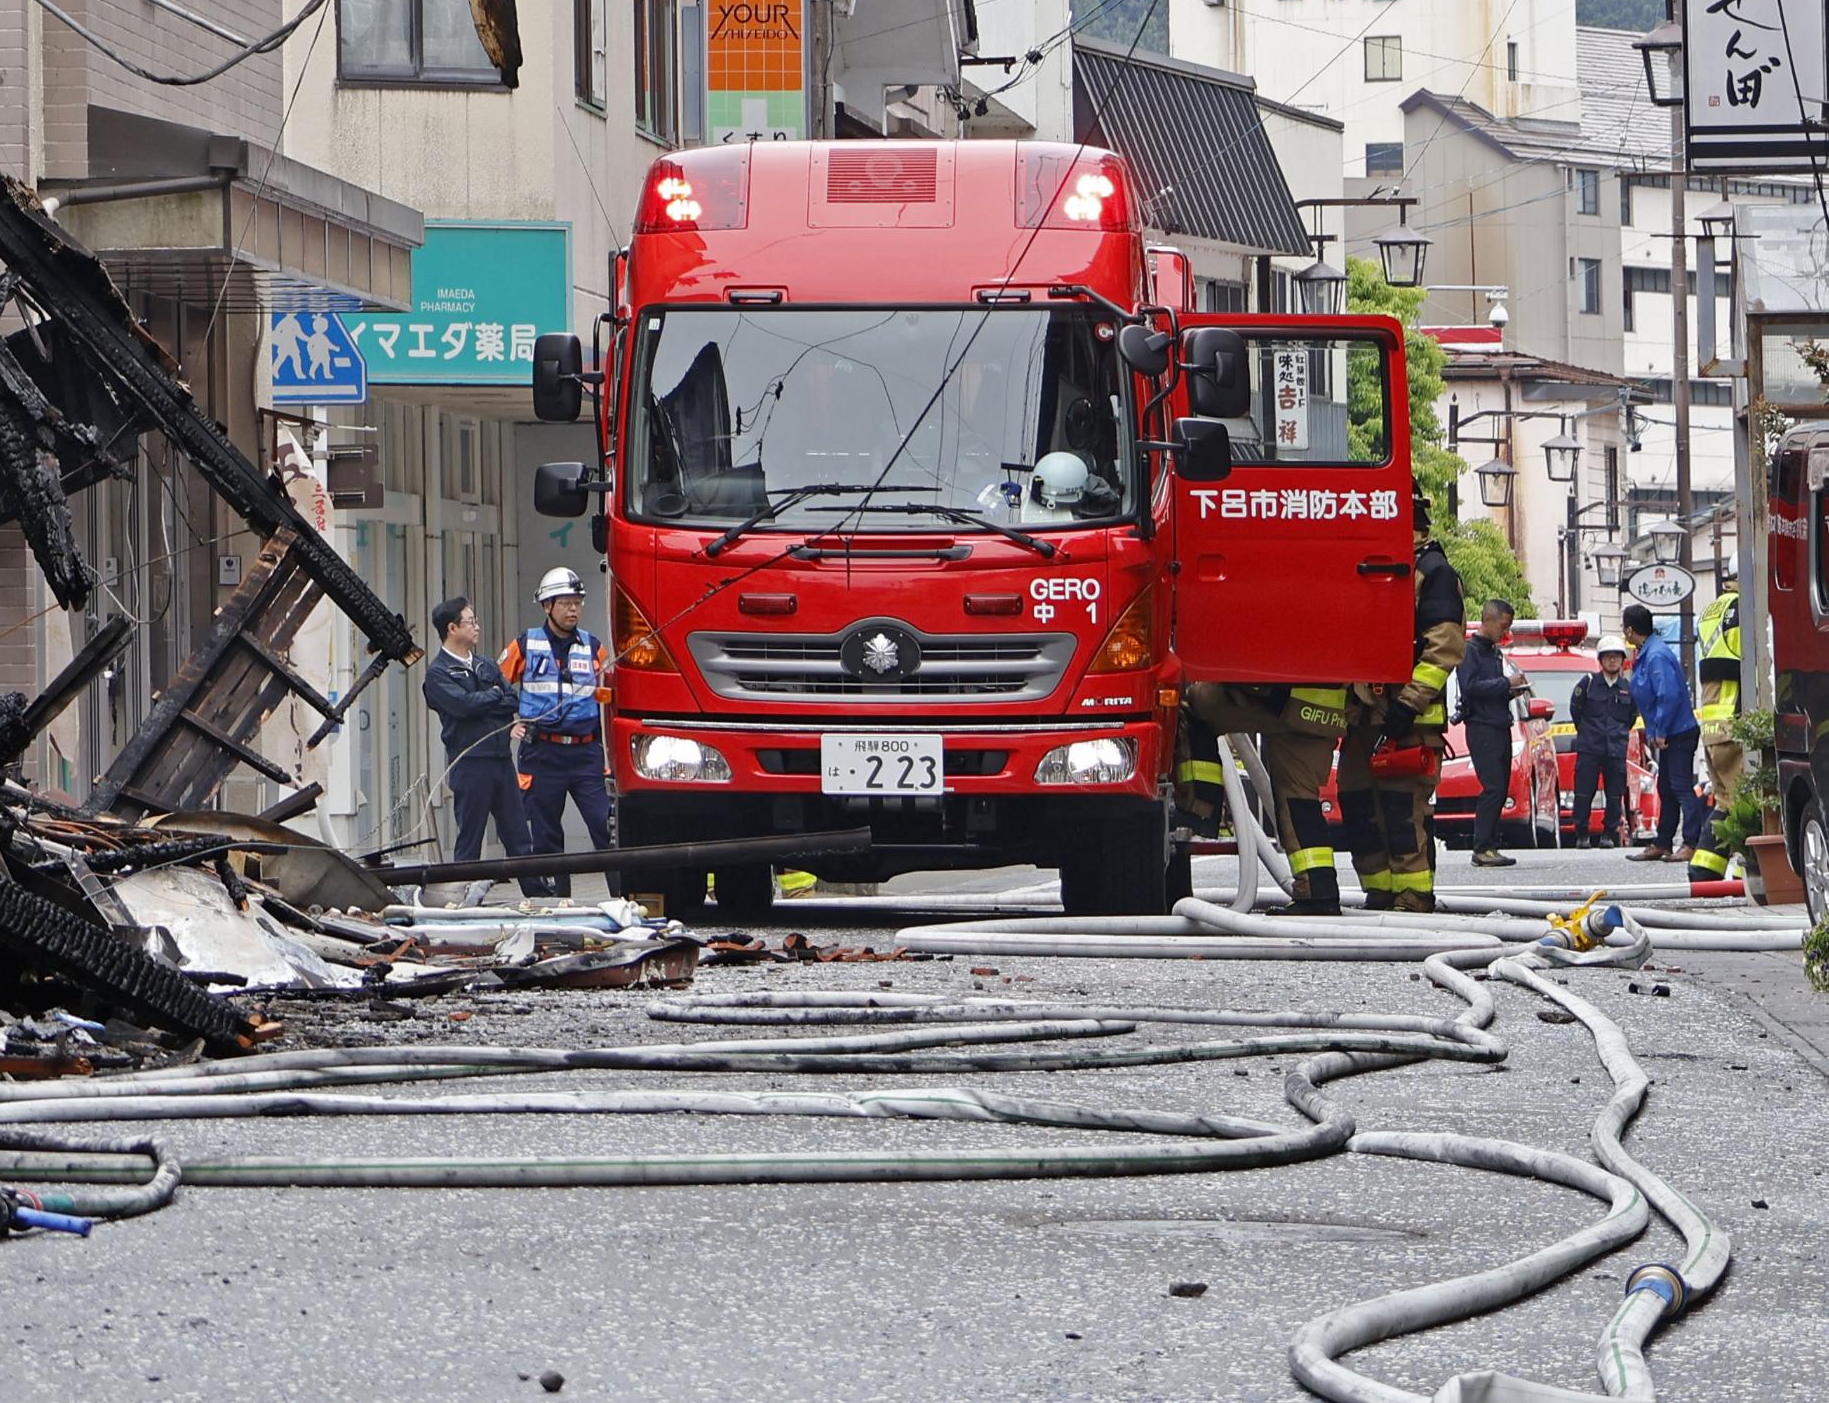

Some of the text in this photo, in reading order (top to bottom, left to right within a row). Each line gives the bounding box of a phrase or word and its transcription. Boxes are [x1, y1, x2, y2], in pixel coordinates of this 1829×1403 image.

[711, 4, 799, 40] YOUR
[722, 29, 788, 40] SHISEIDO
[437, 288, 475, 300] IMAEDA
[420, 301, 475, 313] PHARMACY
[1277, 353, 1298, 445] 味処 吉祥
[1189, 488, 1399, 521] 下呂市消防本部
[1030, 577, 1101, 600] GERO
[1033, 601, 1097, 625] 中 1
[1081, 696, 1132, 706] MORITA
[1300, 705, 1331, 725] GIFU
[828, 766, 840, 777] は
